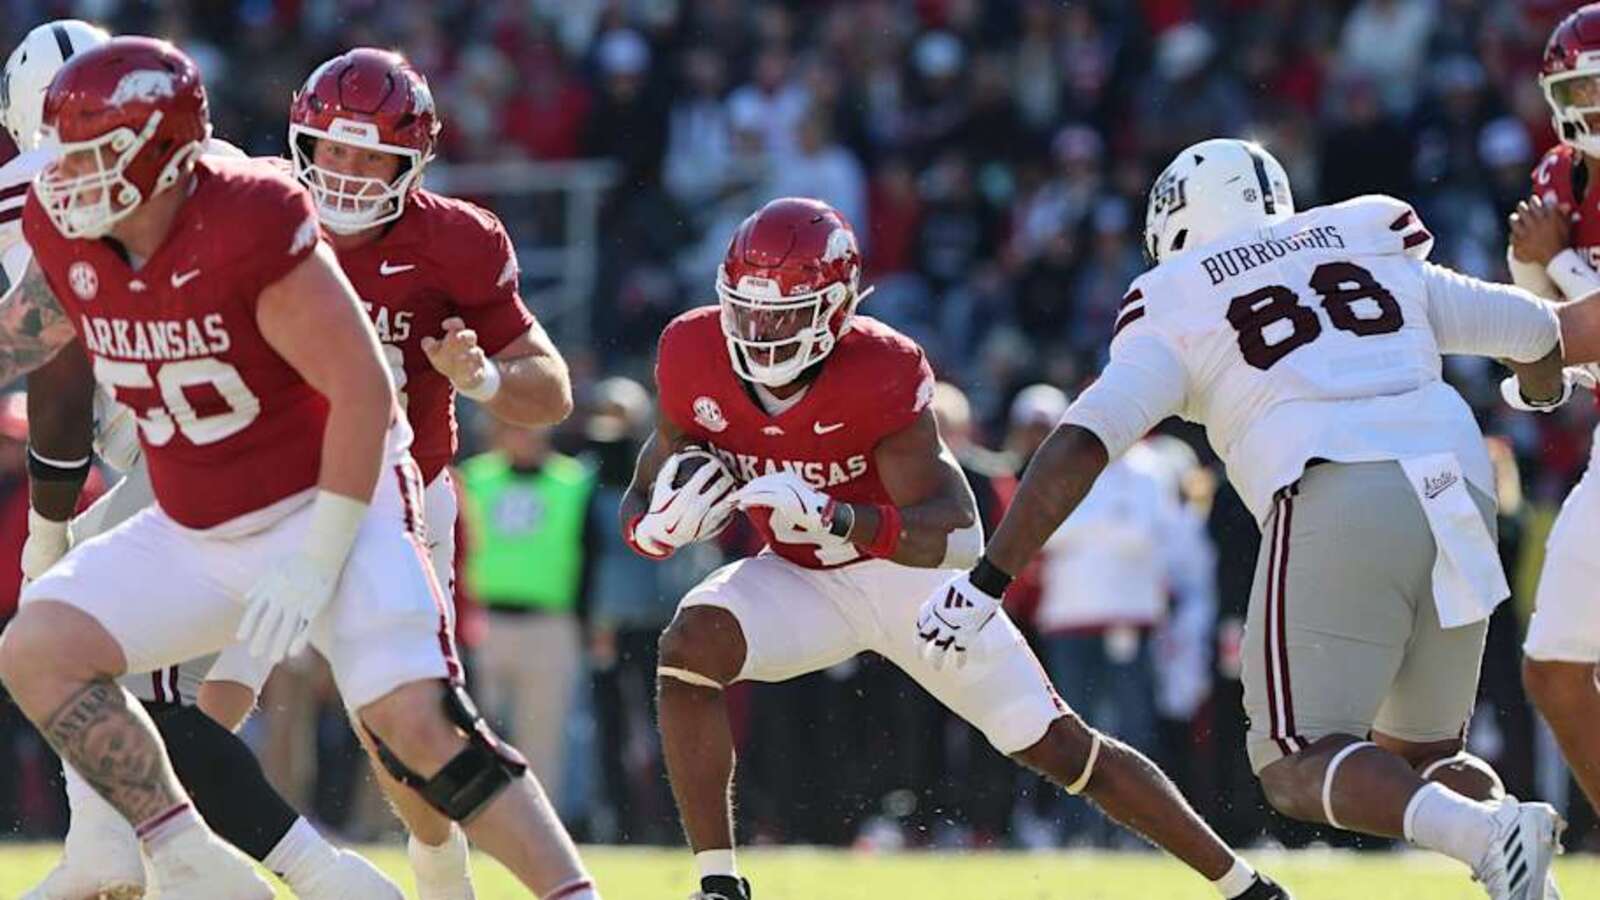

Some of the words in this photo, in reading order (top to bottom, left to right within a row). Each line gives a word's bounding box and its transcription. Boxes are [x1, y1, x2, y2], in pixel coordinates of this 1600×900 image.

[1201, 225, 1345, 285] BURROUGHS
[82, 312, 231, 360] ARKANSAS
[1226, 261, 1404, 370] 88
[93, 354, 260, 446] 50
[714, 445, 867, 490] RKANSAS
